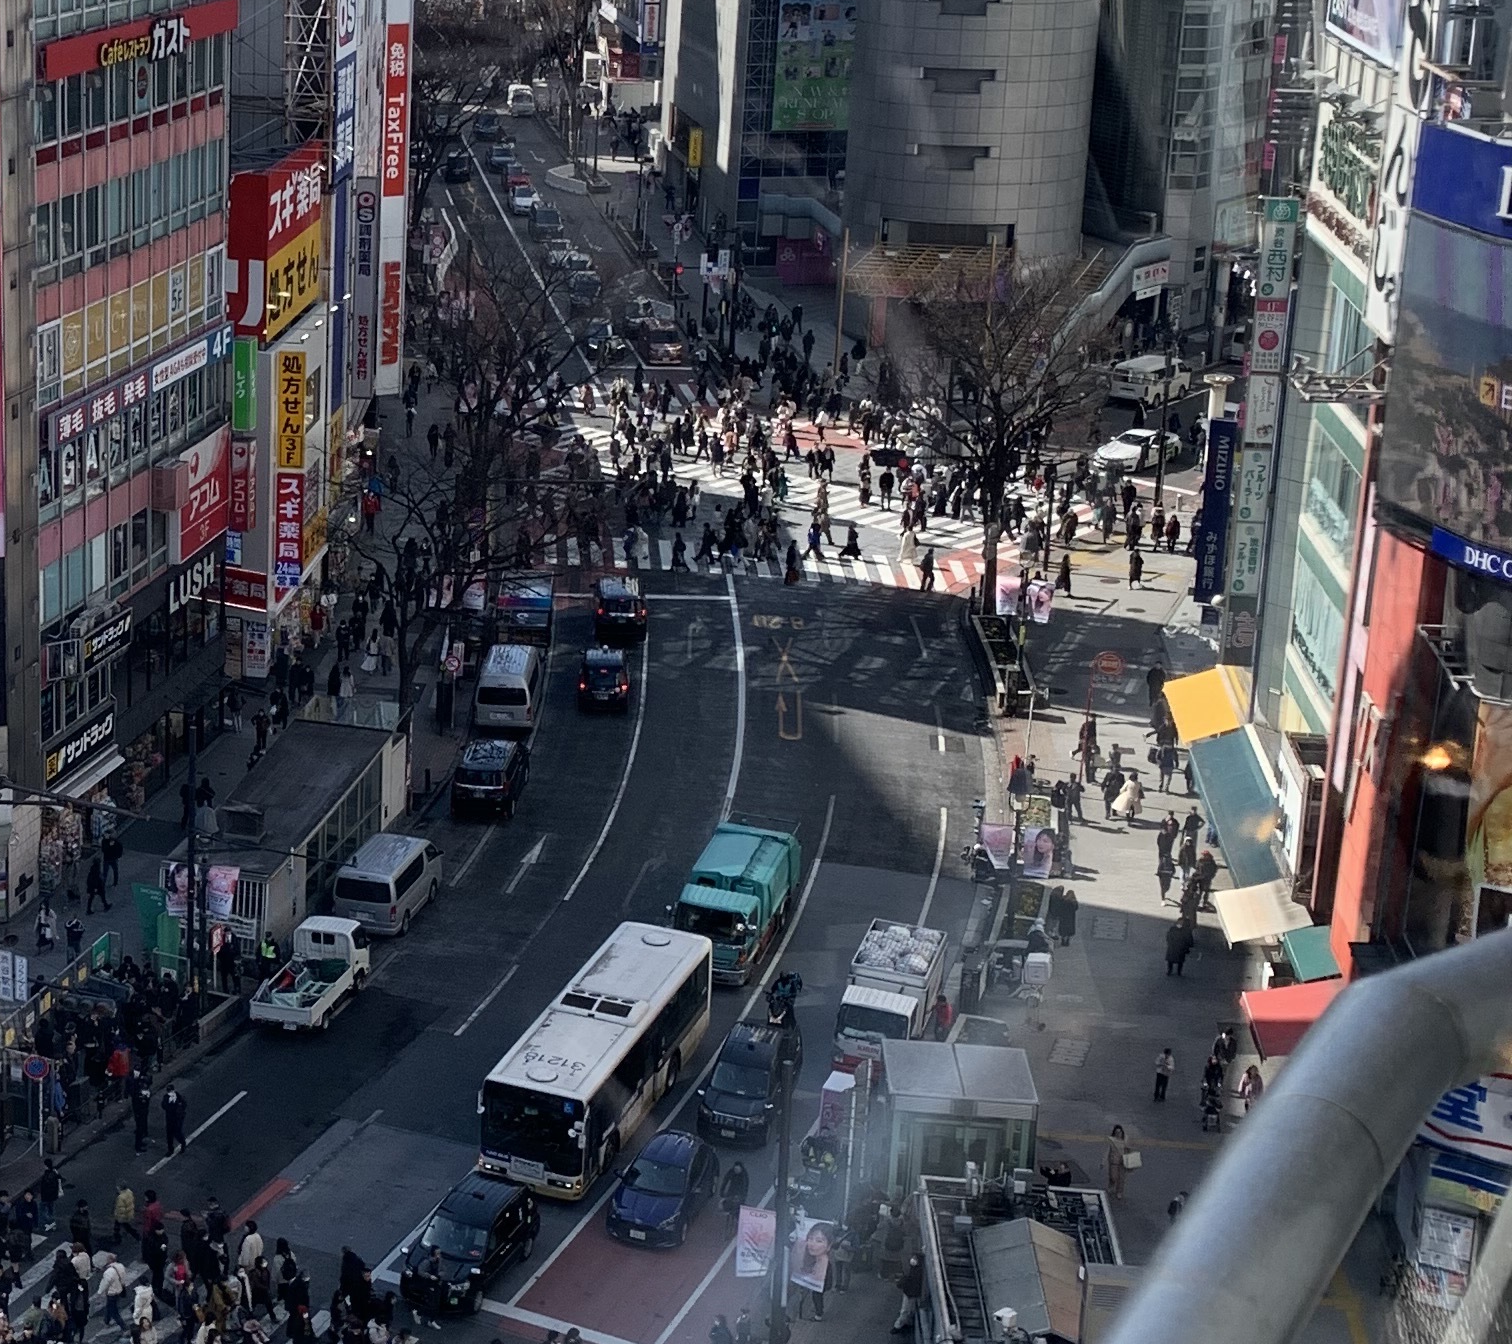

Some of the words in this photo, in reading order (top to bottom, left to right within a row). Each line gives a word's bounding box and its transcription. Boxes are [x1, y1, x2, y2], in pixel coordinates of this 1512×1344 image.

[151, 17, 191, 61] ガスト
[390, 42, 406, 78] 免税
[386, 92, 406, 181] TaxFree
[268, 163, 321, 241] スギ薬局
[171, 288, 183, 314] 5F
[268, 240, 320, 323] 処方せん
[212, 325, 231, 358] 4F
[59, 407, 85, 442] 薄毛
[92, 390, 116, 425] 抜毛
[123, 373, 147, 406] 発毛
[281, 356, 302, 434] 処方せん
[284, 437, 296, 465] 3F
[1214, 435, 1231, 492] MIZUHO
[189, 481, 220, 521] アコム
[1255, 463, 1267, 501] フルーツ
[279, 476, 300, 560] スギ薬局
[169, 551, 216, 615] LUSH
[1464, 545, 1501, 575] DHC
[66, 712, 114, 764] サンドラッグ
